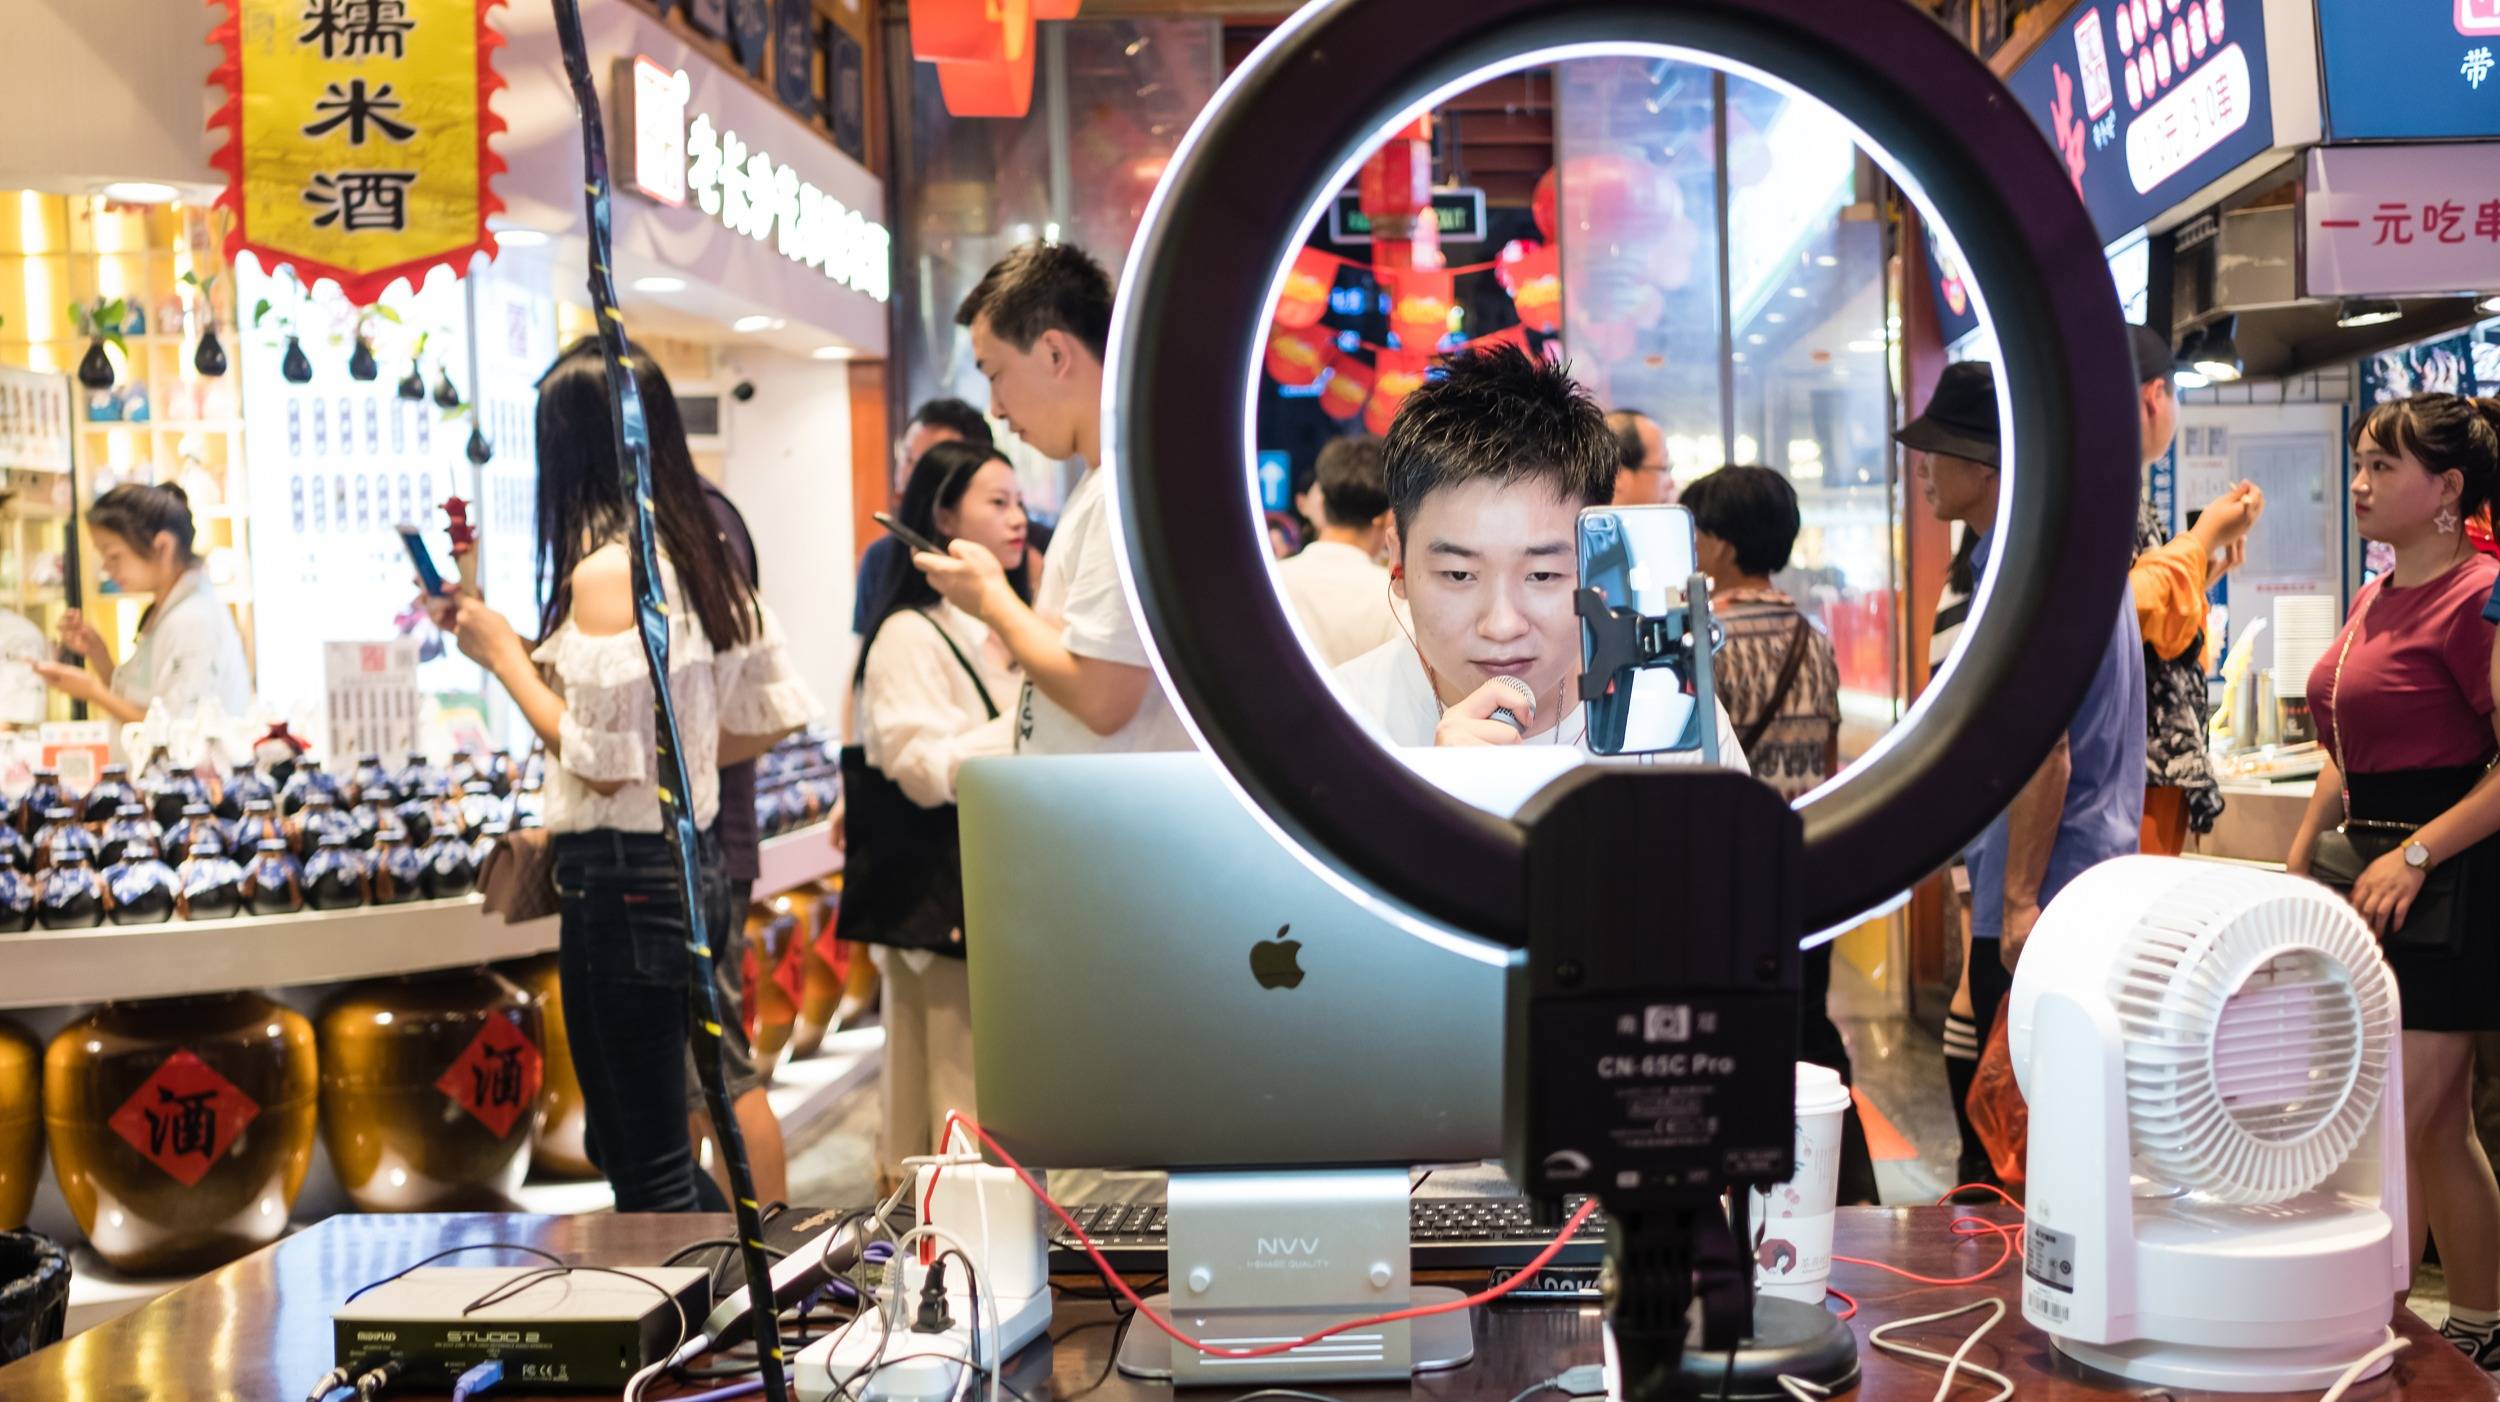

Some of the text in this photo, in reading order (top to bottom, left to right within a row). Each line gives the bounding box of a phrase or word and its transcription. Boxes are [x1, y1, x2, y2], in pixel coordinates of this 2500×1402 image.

[299, 0, 416, 232] 糯米酒
[473, 1043, 523, 1108] 酒
[1597, 1053, 1736, 1078] CN-65C Pro
[144, 1085, 219, 1158] 酒
[1257, 1237, 1319, 1255] NVV
[447, 1331, 540, 1343] STUDIO 2
